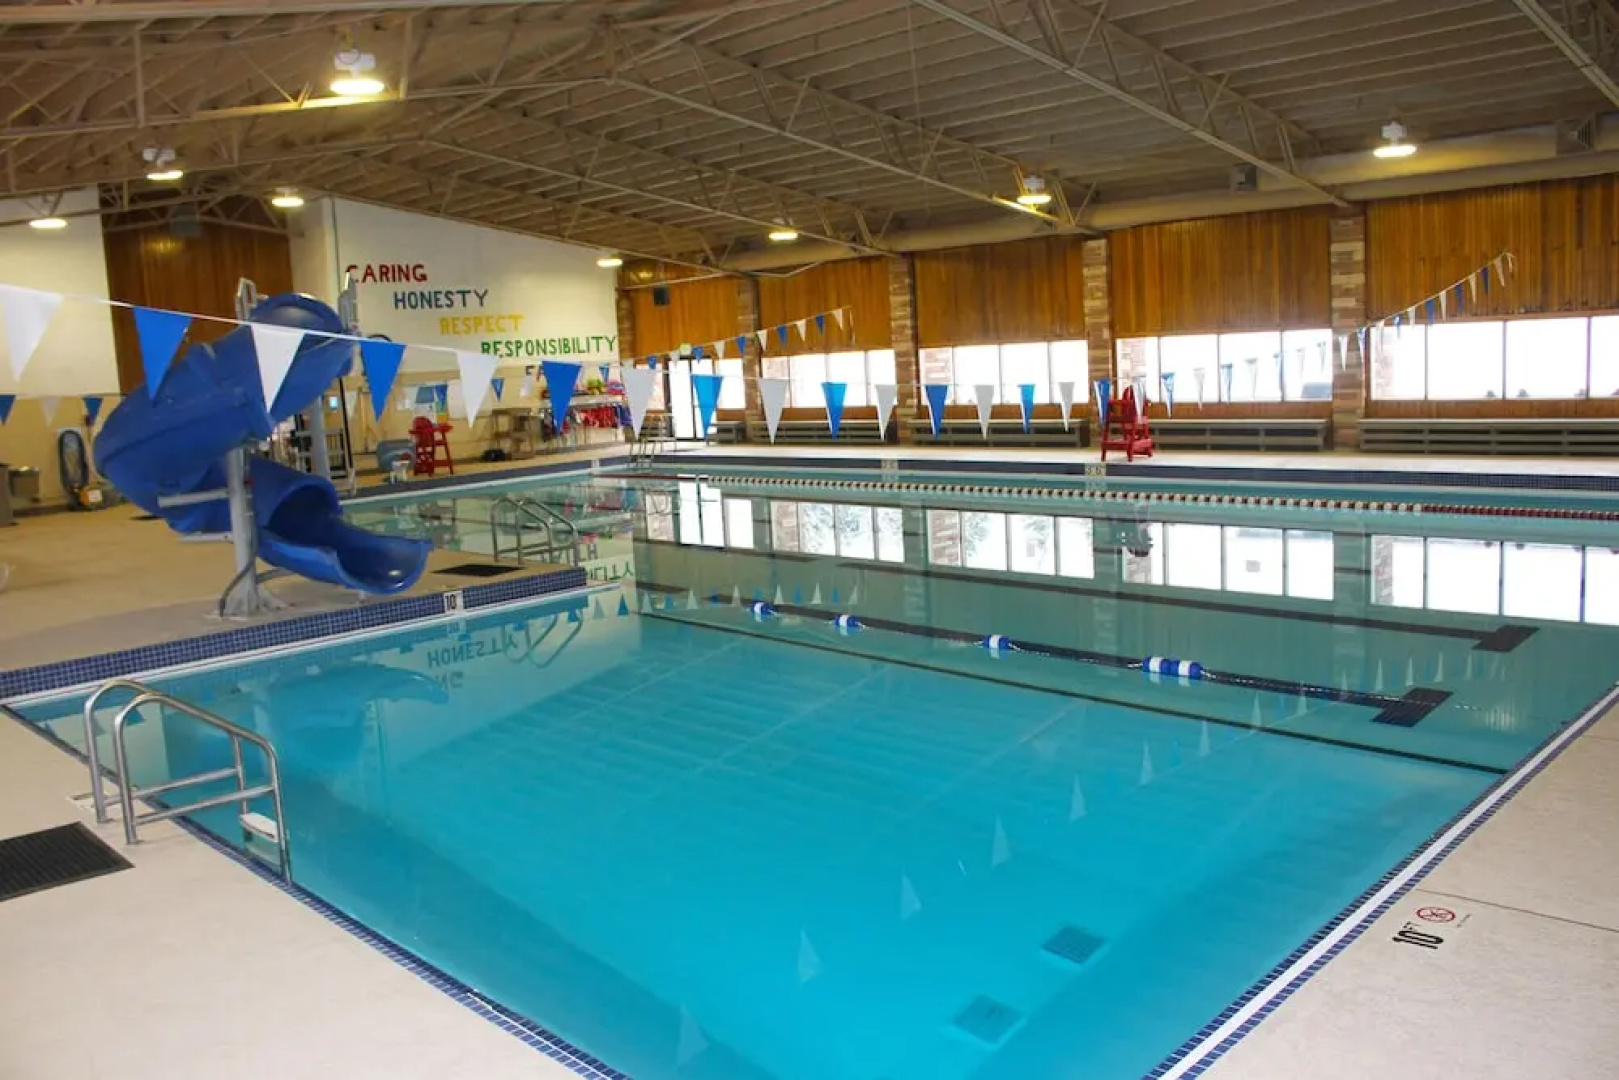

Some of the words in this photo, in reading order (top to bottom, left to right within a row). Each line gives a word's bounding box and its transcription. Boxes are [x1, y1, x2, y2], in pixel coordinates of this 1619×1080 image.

[345, 263, 428, 284] CARING
[393, 288, 488, 310] HONESTY
[439, 313, 525, 336] RESPECT
[480, 336, 616, 358] RESPONSIBILITY
[444, 593, 458, 612] 10
[1391, 930, 1444, 950] 10
